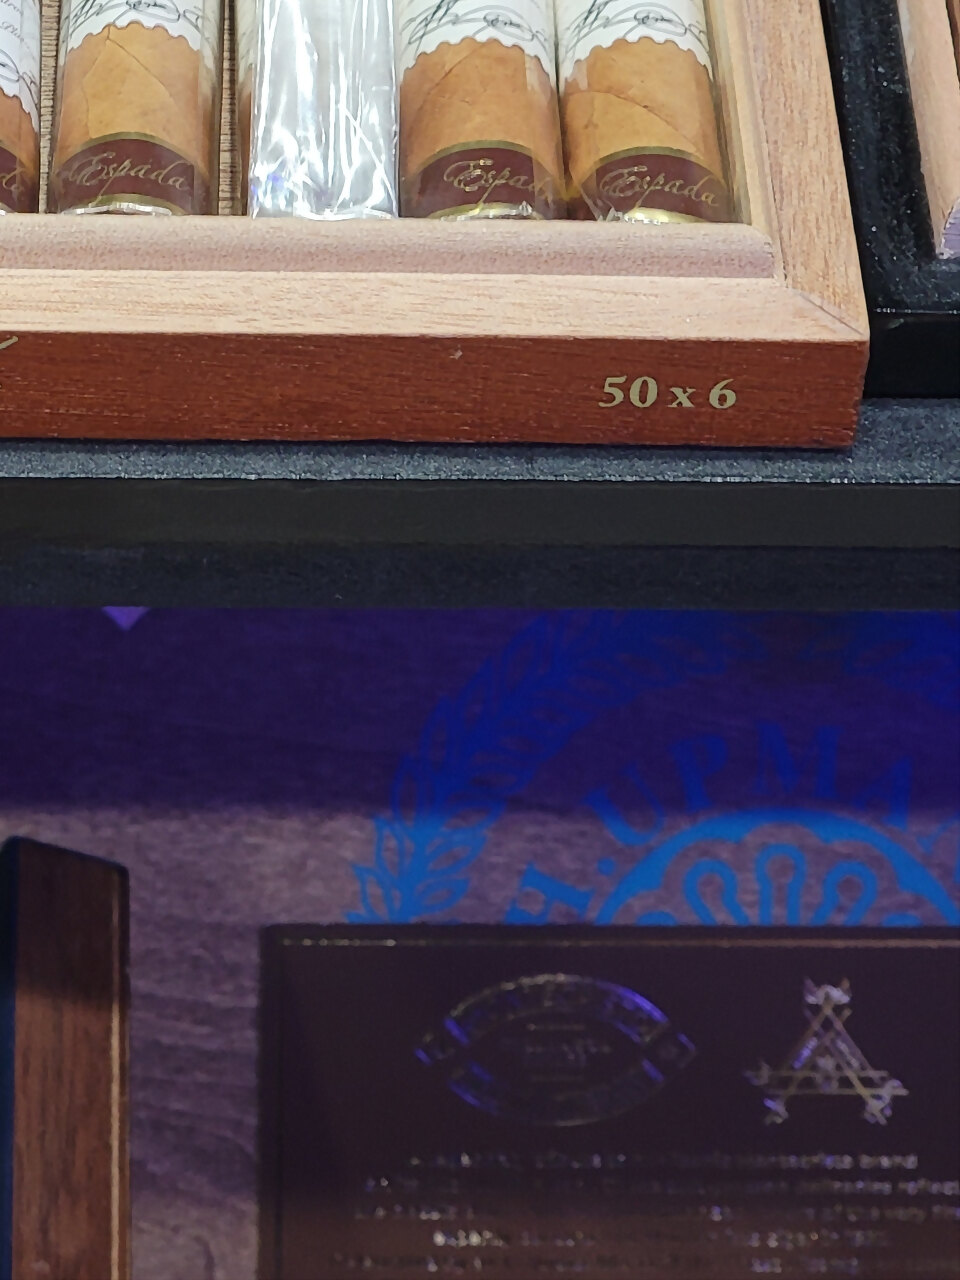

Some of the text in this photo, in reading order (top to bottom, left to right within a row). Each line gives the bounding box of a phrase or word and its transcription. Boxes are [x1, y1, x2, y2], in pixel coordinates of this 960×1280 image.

[67, 151, 193, 206] Espada
[600, 165, 718, 209] Espada
[598, 375, 737, 409] 50 x 6
